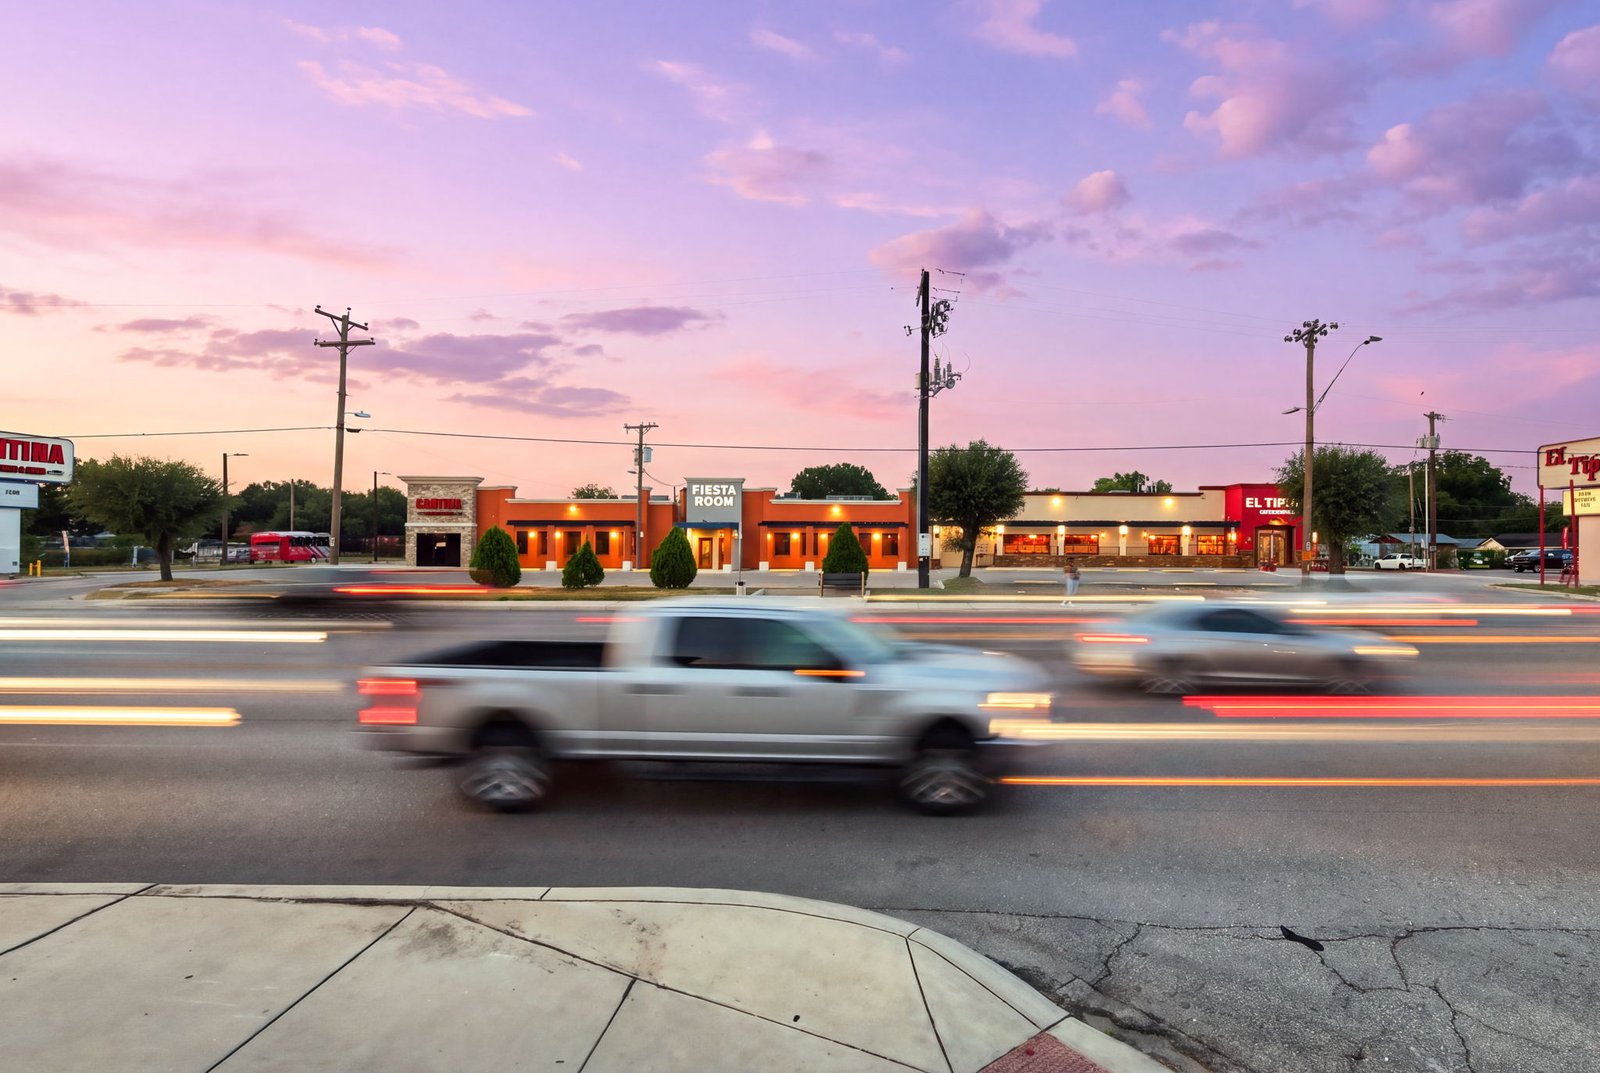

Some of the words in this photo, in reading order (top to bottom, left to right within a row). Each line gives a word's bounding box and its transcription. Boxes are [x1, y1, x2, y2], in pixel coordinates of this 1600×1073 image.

[1545, 446, 1567, 466] El
[692, 484, 737, 495] FIESTA
[415, 498, 463, 509] CANTINA
[694, 496, 734, 507] ROOM
[1245, 497, 1263, 508] EL
[1264, 497, 1299, 508] TIP
